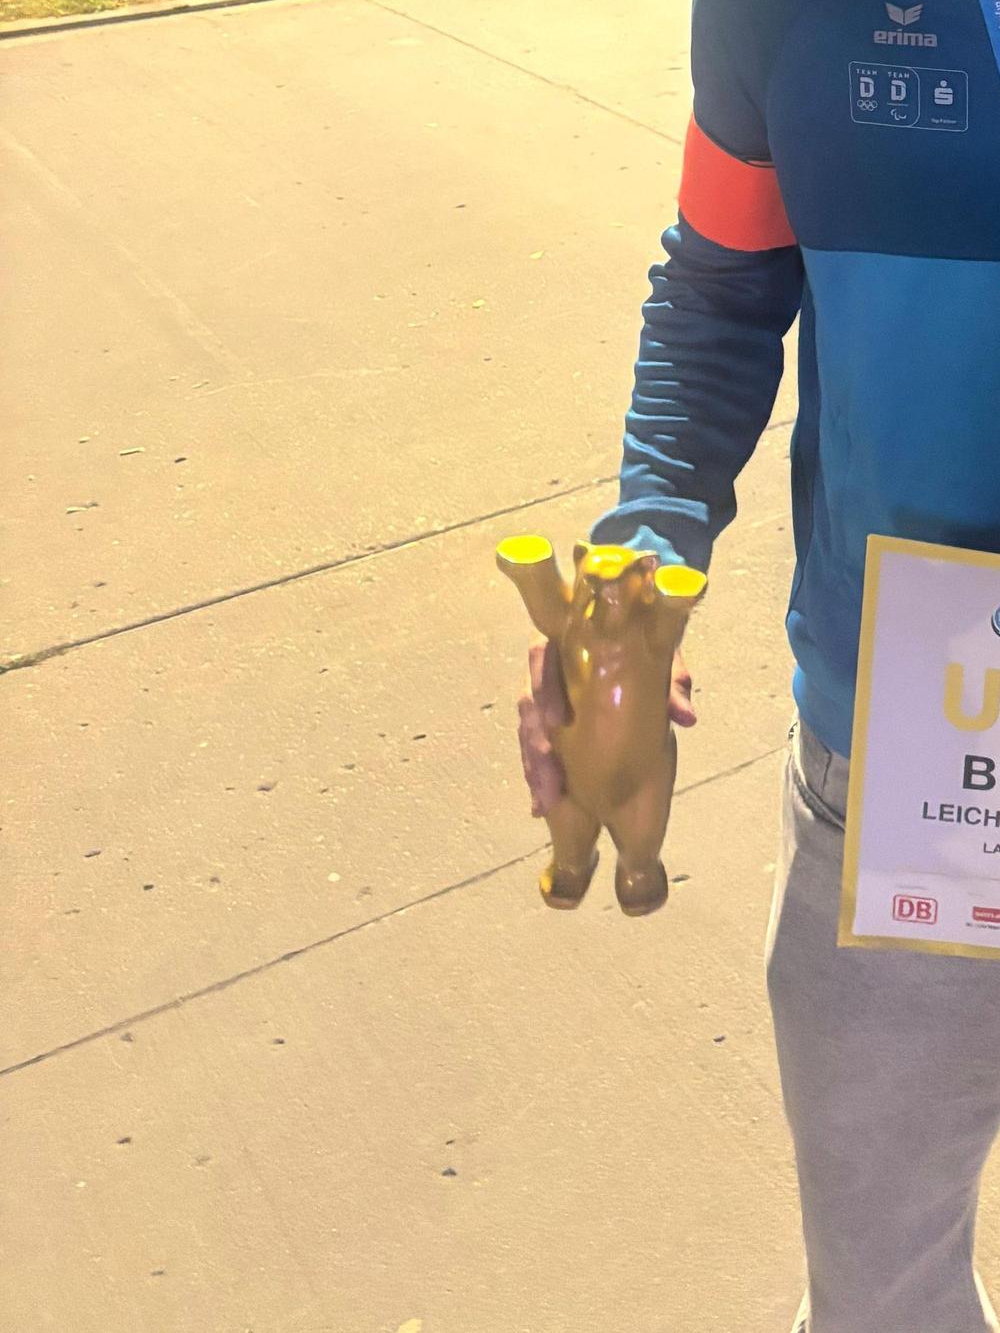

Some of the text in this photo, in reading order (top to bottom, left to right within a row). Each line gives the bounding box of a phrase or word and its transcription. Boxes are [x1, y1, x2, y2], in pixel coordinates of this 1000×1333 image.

[873, 28, 938, 47] erima
[856, 68, 878, 76] TEAM
[888, 71, 910, 79] TEAM
[899, 898, 933, 920] DB
